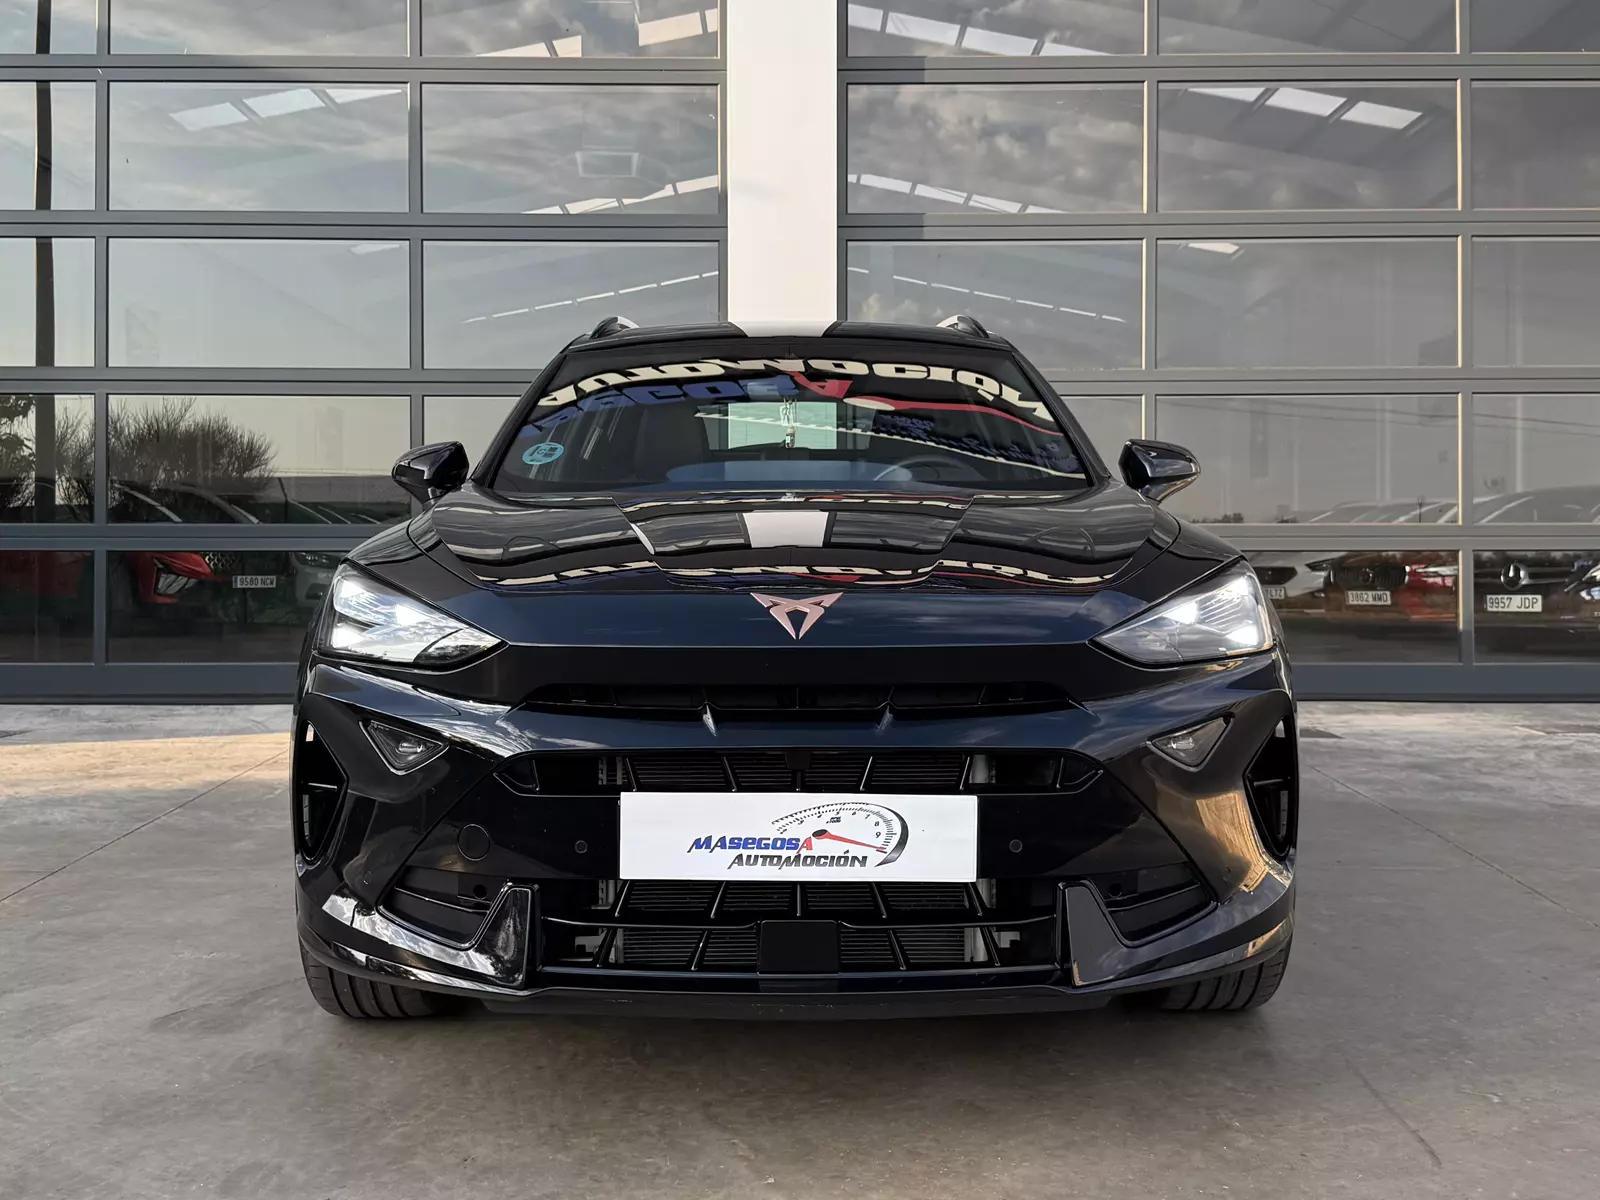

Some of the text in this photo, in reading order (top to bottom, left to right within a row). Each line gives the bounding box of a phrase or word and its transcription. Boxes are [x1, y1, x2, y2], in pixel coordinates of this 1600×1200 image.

[1488, 596, 1539, 609] 9957 JDP
[686, 835, 813, 854] MASEGOSA
[727, 850, 868, 870] AUTOMOCIÓN
